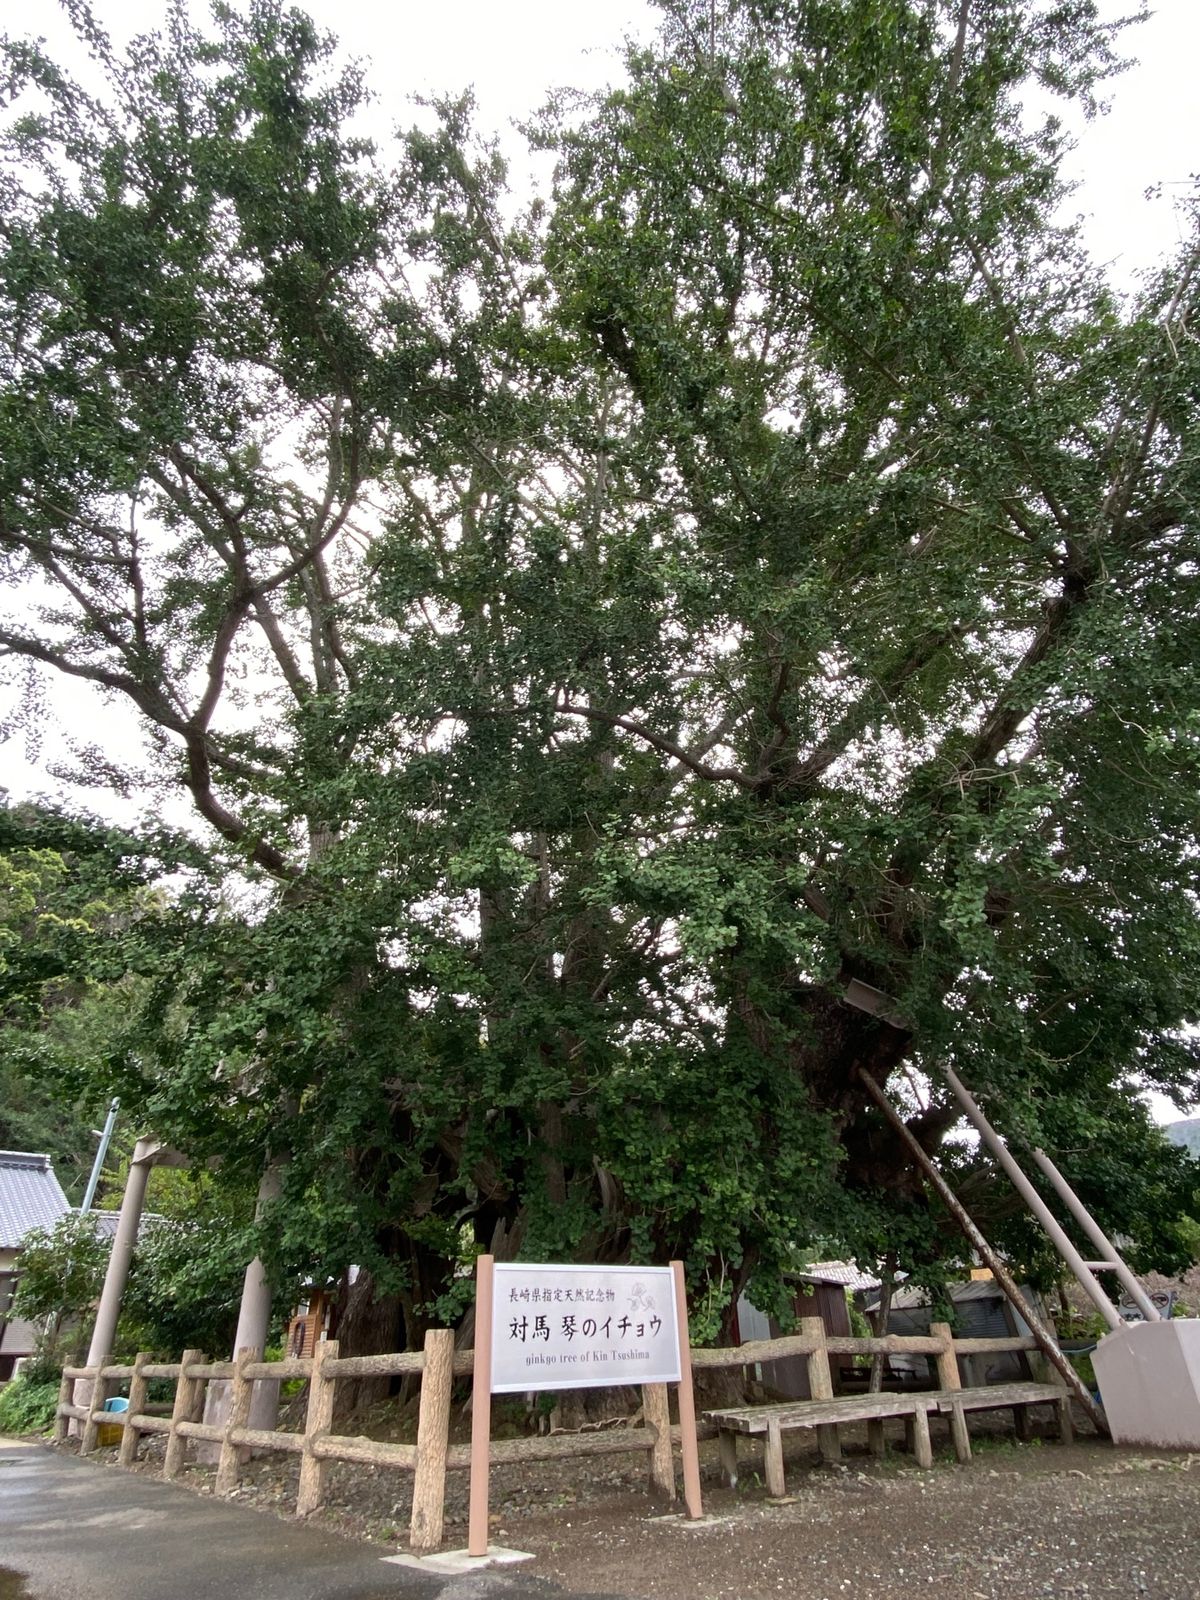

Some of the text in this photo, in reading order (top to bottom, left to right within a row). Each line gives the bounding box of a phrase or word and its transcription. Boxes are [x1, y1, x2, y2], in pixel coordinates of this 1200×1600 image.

[509, 1287, 615, 1302] 長崎県指定天然記念物
[509, 1314, 662, 1342] 対馬 琴のイチョウ
[526, 1348, 650, 1366] ginkgo tree of Kin Tsushima
